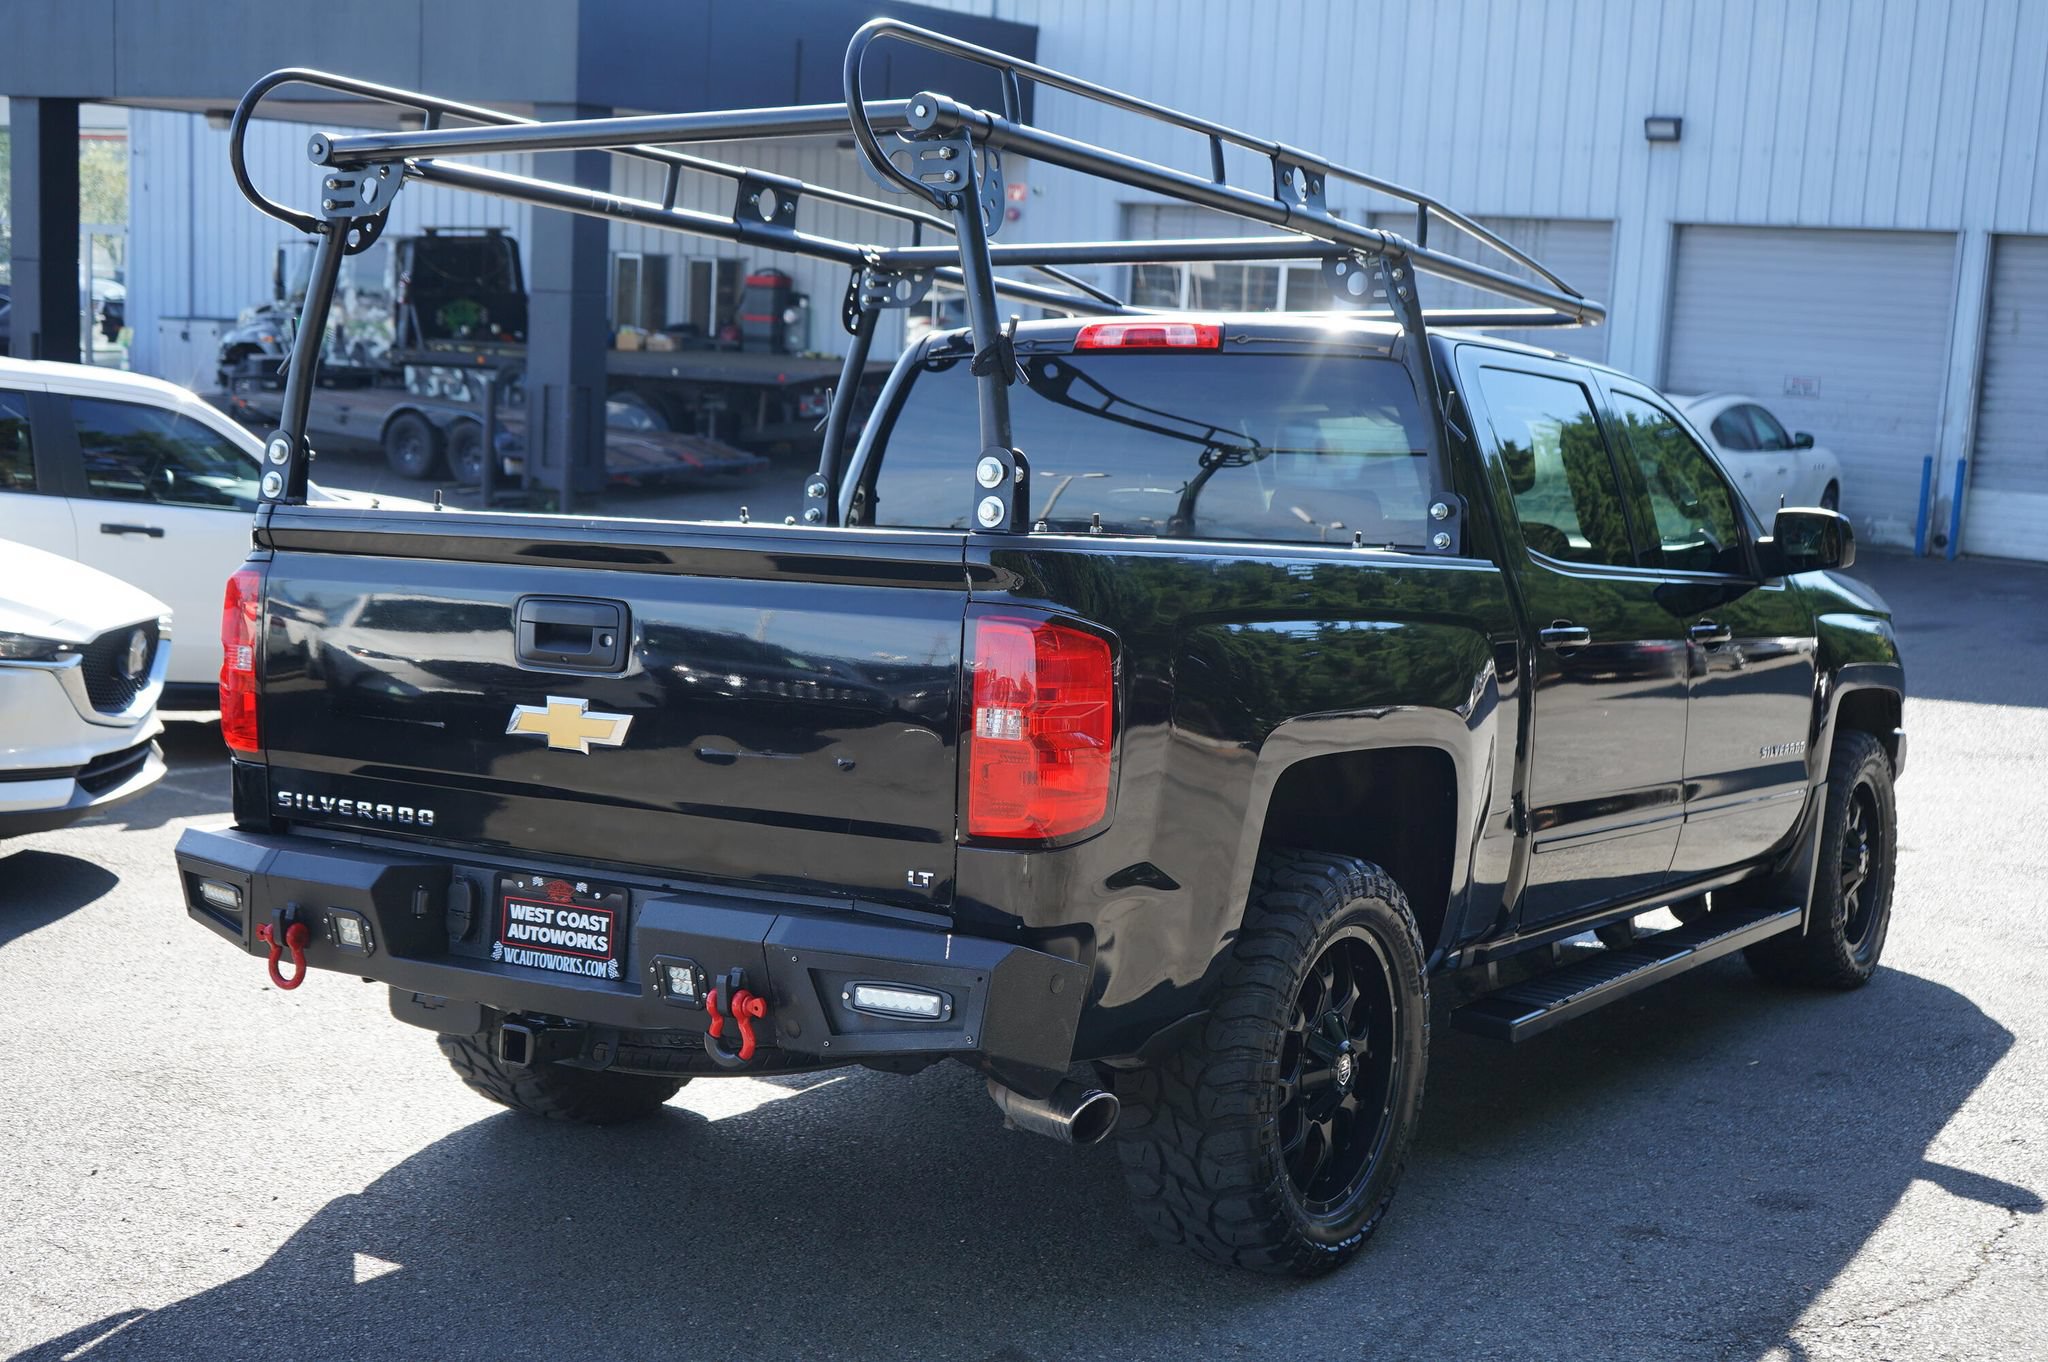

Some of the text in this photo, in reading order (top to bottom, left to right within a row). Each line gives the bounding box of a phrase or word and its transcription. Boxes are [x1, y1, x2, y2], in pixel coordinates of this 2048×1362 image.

[1761, 740, 1806, 759] SILVERADO
[278, 790, 434, 827] SILVERADO
[907, 870, 934, 888] LT
[510, 903, 609, 933] WEST COAST
[507, 923, 608, 952] AUTOWORKS
[504, 947, 607, 978] WCAUTOWORKS.COM
